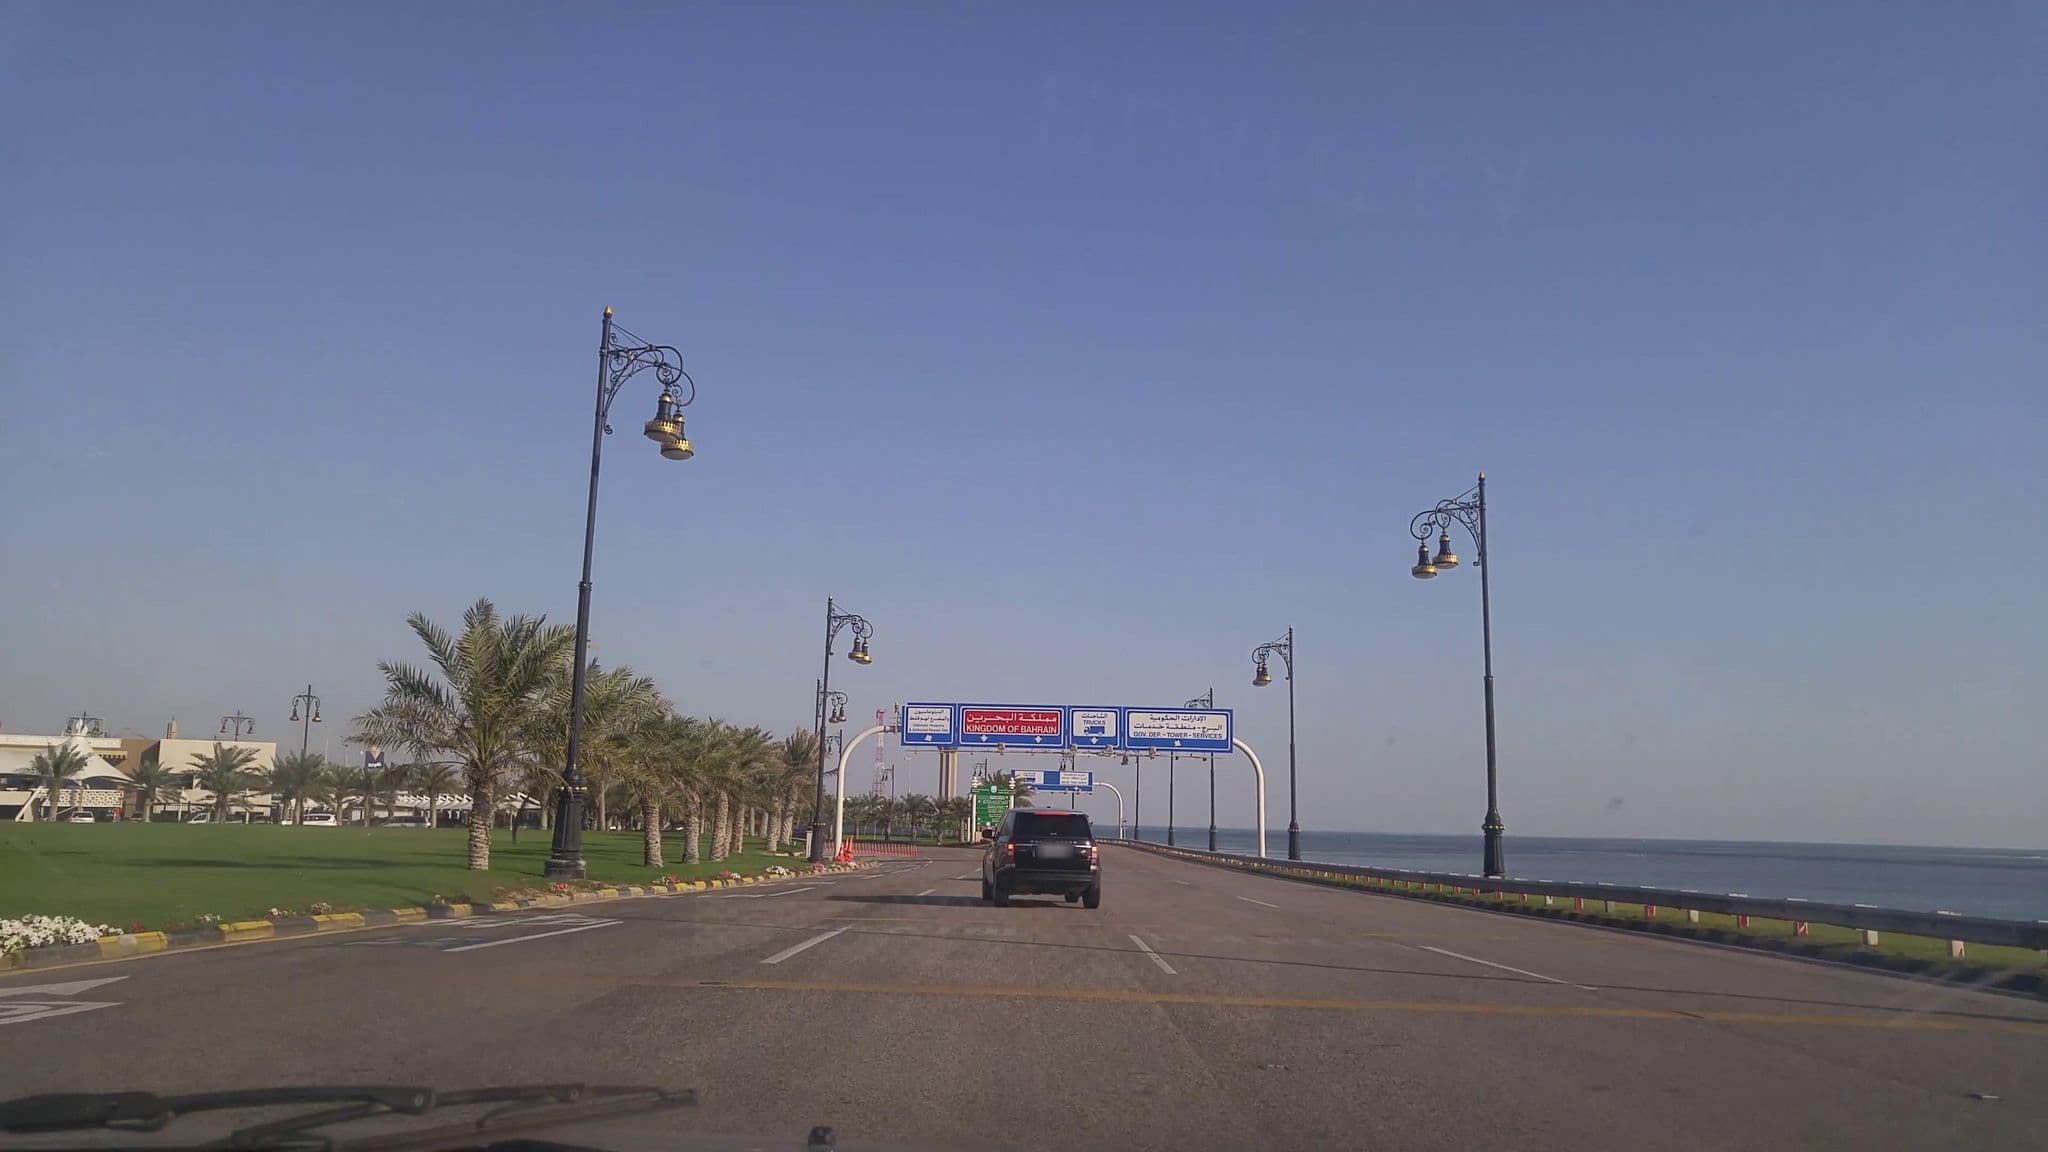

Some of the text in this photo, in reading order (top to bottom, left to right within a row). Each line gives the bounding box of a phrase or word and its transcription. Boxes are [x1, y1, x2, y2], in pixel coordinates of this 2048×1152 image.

[967, 712, 1057, 723] مملكة البحرين
[966, 724, 1057, 734] KINGDOM OF BAHRAIN
